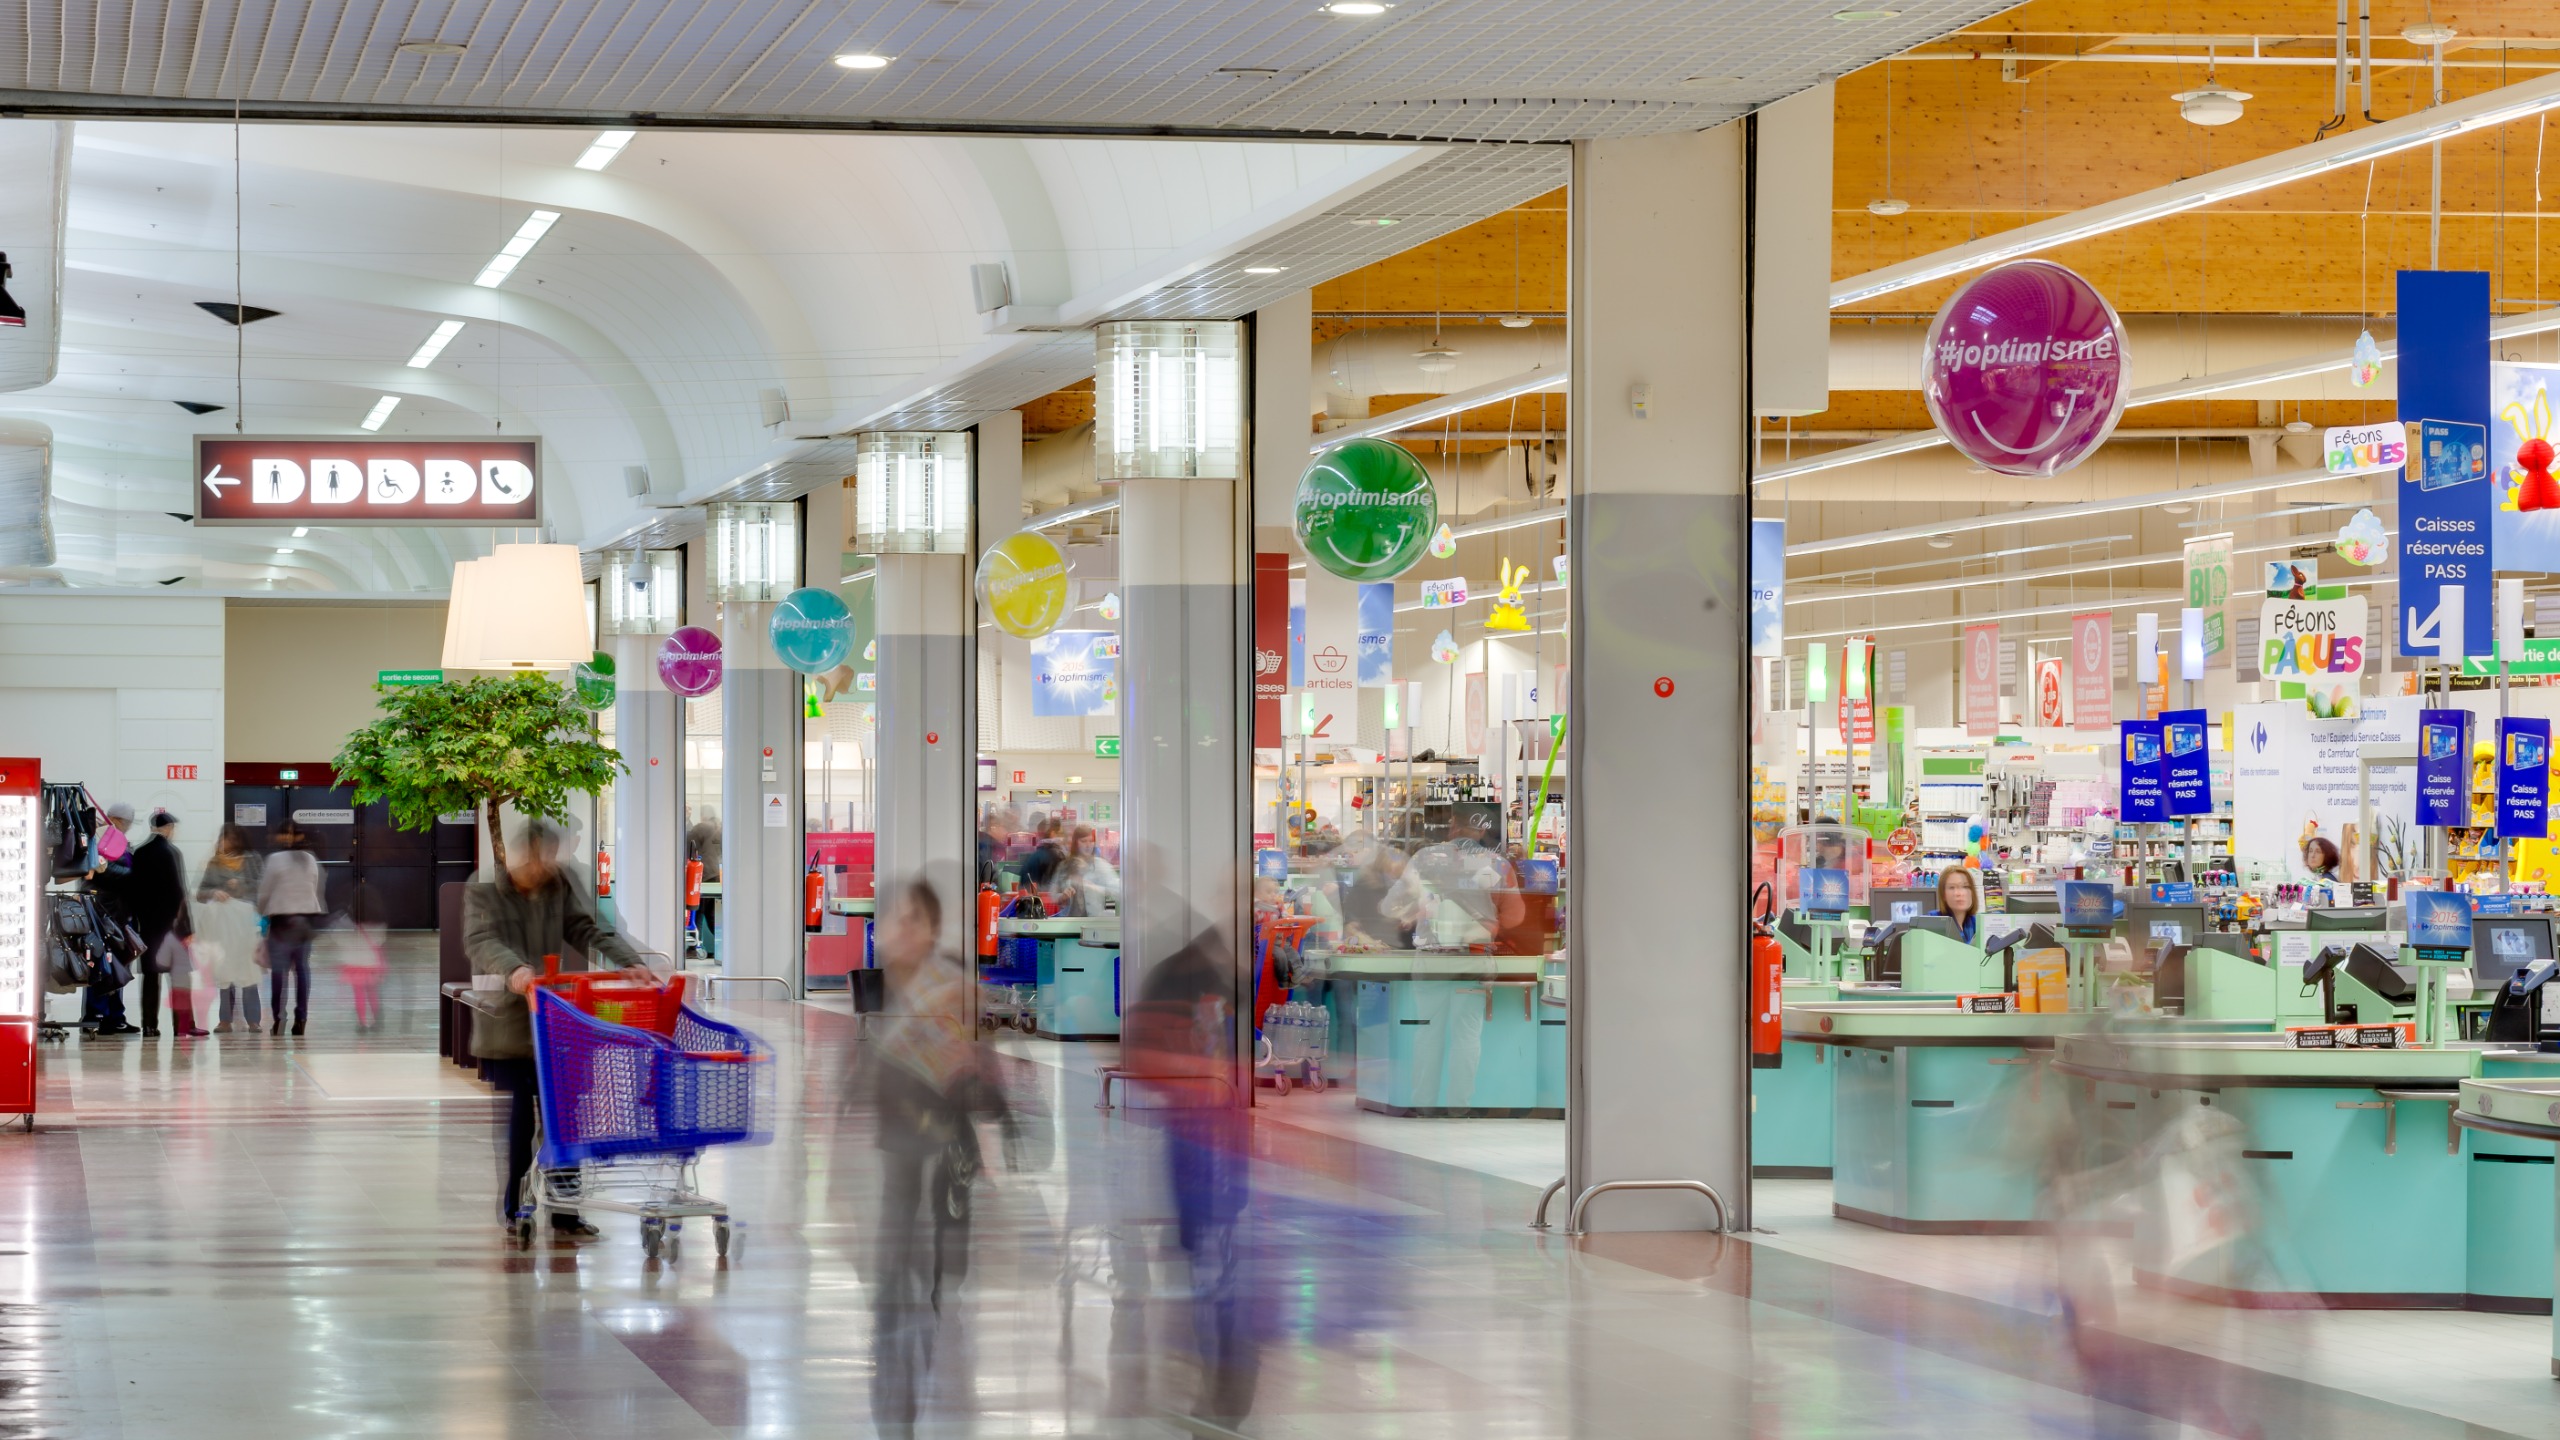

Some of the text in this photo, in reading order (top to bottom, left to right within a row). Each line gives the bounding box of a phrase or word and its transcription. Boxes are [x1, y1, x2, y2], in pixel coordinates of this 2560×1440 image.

[1940, 335, 2112, 373] #joptimisme
[2429, 427, 2449, 436] PASS
[2335, 429, 2383, 448] Fêtons
[2329, 442, 2405, 471] PÂQUES
[1301, 487, 1433, 510] #joptimisme
[2415, 517, 2475, 532] Caisses
[2407, 539, 2484, 556] réservées
[2425, 564, 2466, 579] PASS
[2274, 604, 2336, 634] Fêtons
[2263, 632, 2363, 676] PÂQUES
[1307, 678, 1353, 689] articles
[2311, 733, 2326, 742] Toute
[2358, 732, 2379, 742] Service
[2380, 732, 2400, 742] Caisses
[2319, 748, 2326, 758] de
[2327, 748, 2355, 758] Carrefour
[2172, 769, 2198, 777] Caisse
[2313, 765, 2321, 774] est
[2323, 764, 2348, 773] heureuse
[2132, 777, 2158, 785] Caisse
[2168, 779, 2203, 788] réservée
[2428, 774, 2451, 783] Caisse
[2128, 787, 2162, 796] réservée
[2302, 781, 2315, 791] Nous
[2316, 782, 2327, 791] vous
[2389, 781, 2407, 793] rapide
[2423, 786, 2454, 796] réservée
[2511, 784, 2538, 794] Caisse
[2175, 790, 2196, 799] PASS
[2134, 798, 2155, 806] PASS
[2327, 797, 2333, 805] et
[2429, 799, 2449, 808] PASS
[2506, 797, 2542, 806] réservée
[2513, 810, 2535, 819] PASS
[2076, 897, 2102, 908] 2015
[2430, 911, 2459, 924] 2015
